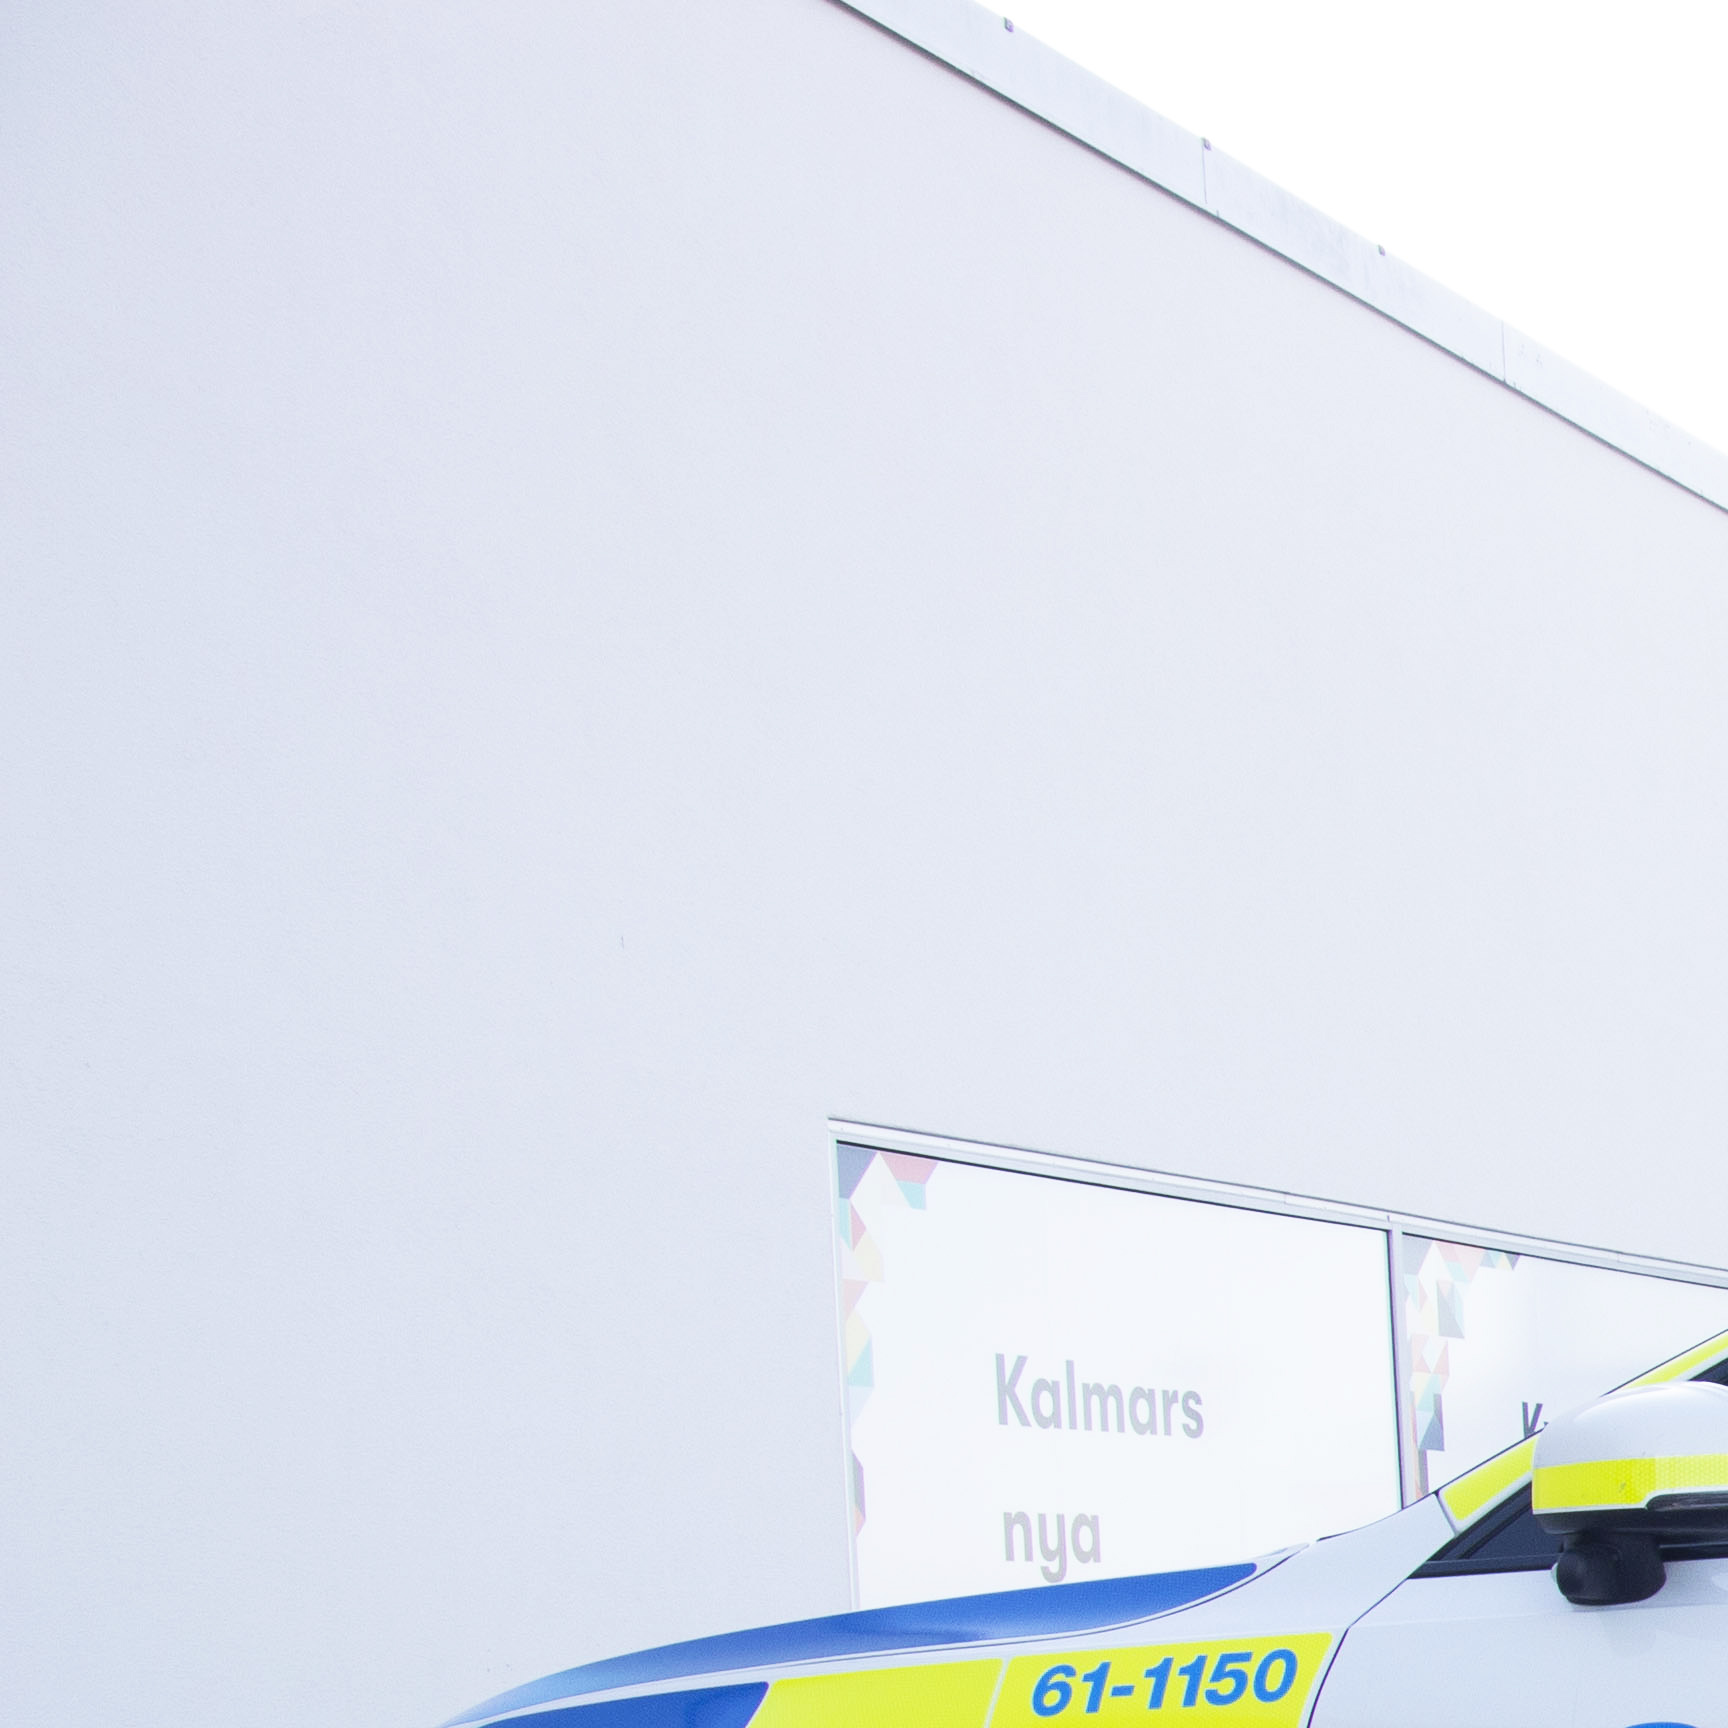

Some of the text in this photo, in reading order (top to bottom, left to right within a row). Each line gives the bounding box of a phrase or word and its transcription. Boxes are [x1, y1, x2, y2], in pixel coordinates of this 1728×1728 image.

[995, 1353, 1205, 1439] Kalmars
[1003, 1511, 1101, 1583] nya
[1032, 1648, 1298, 1717] 61-1150
